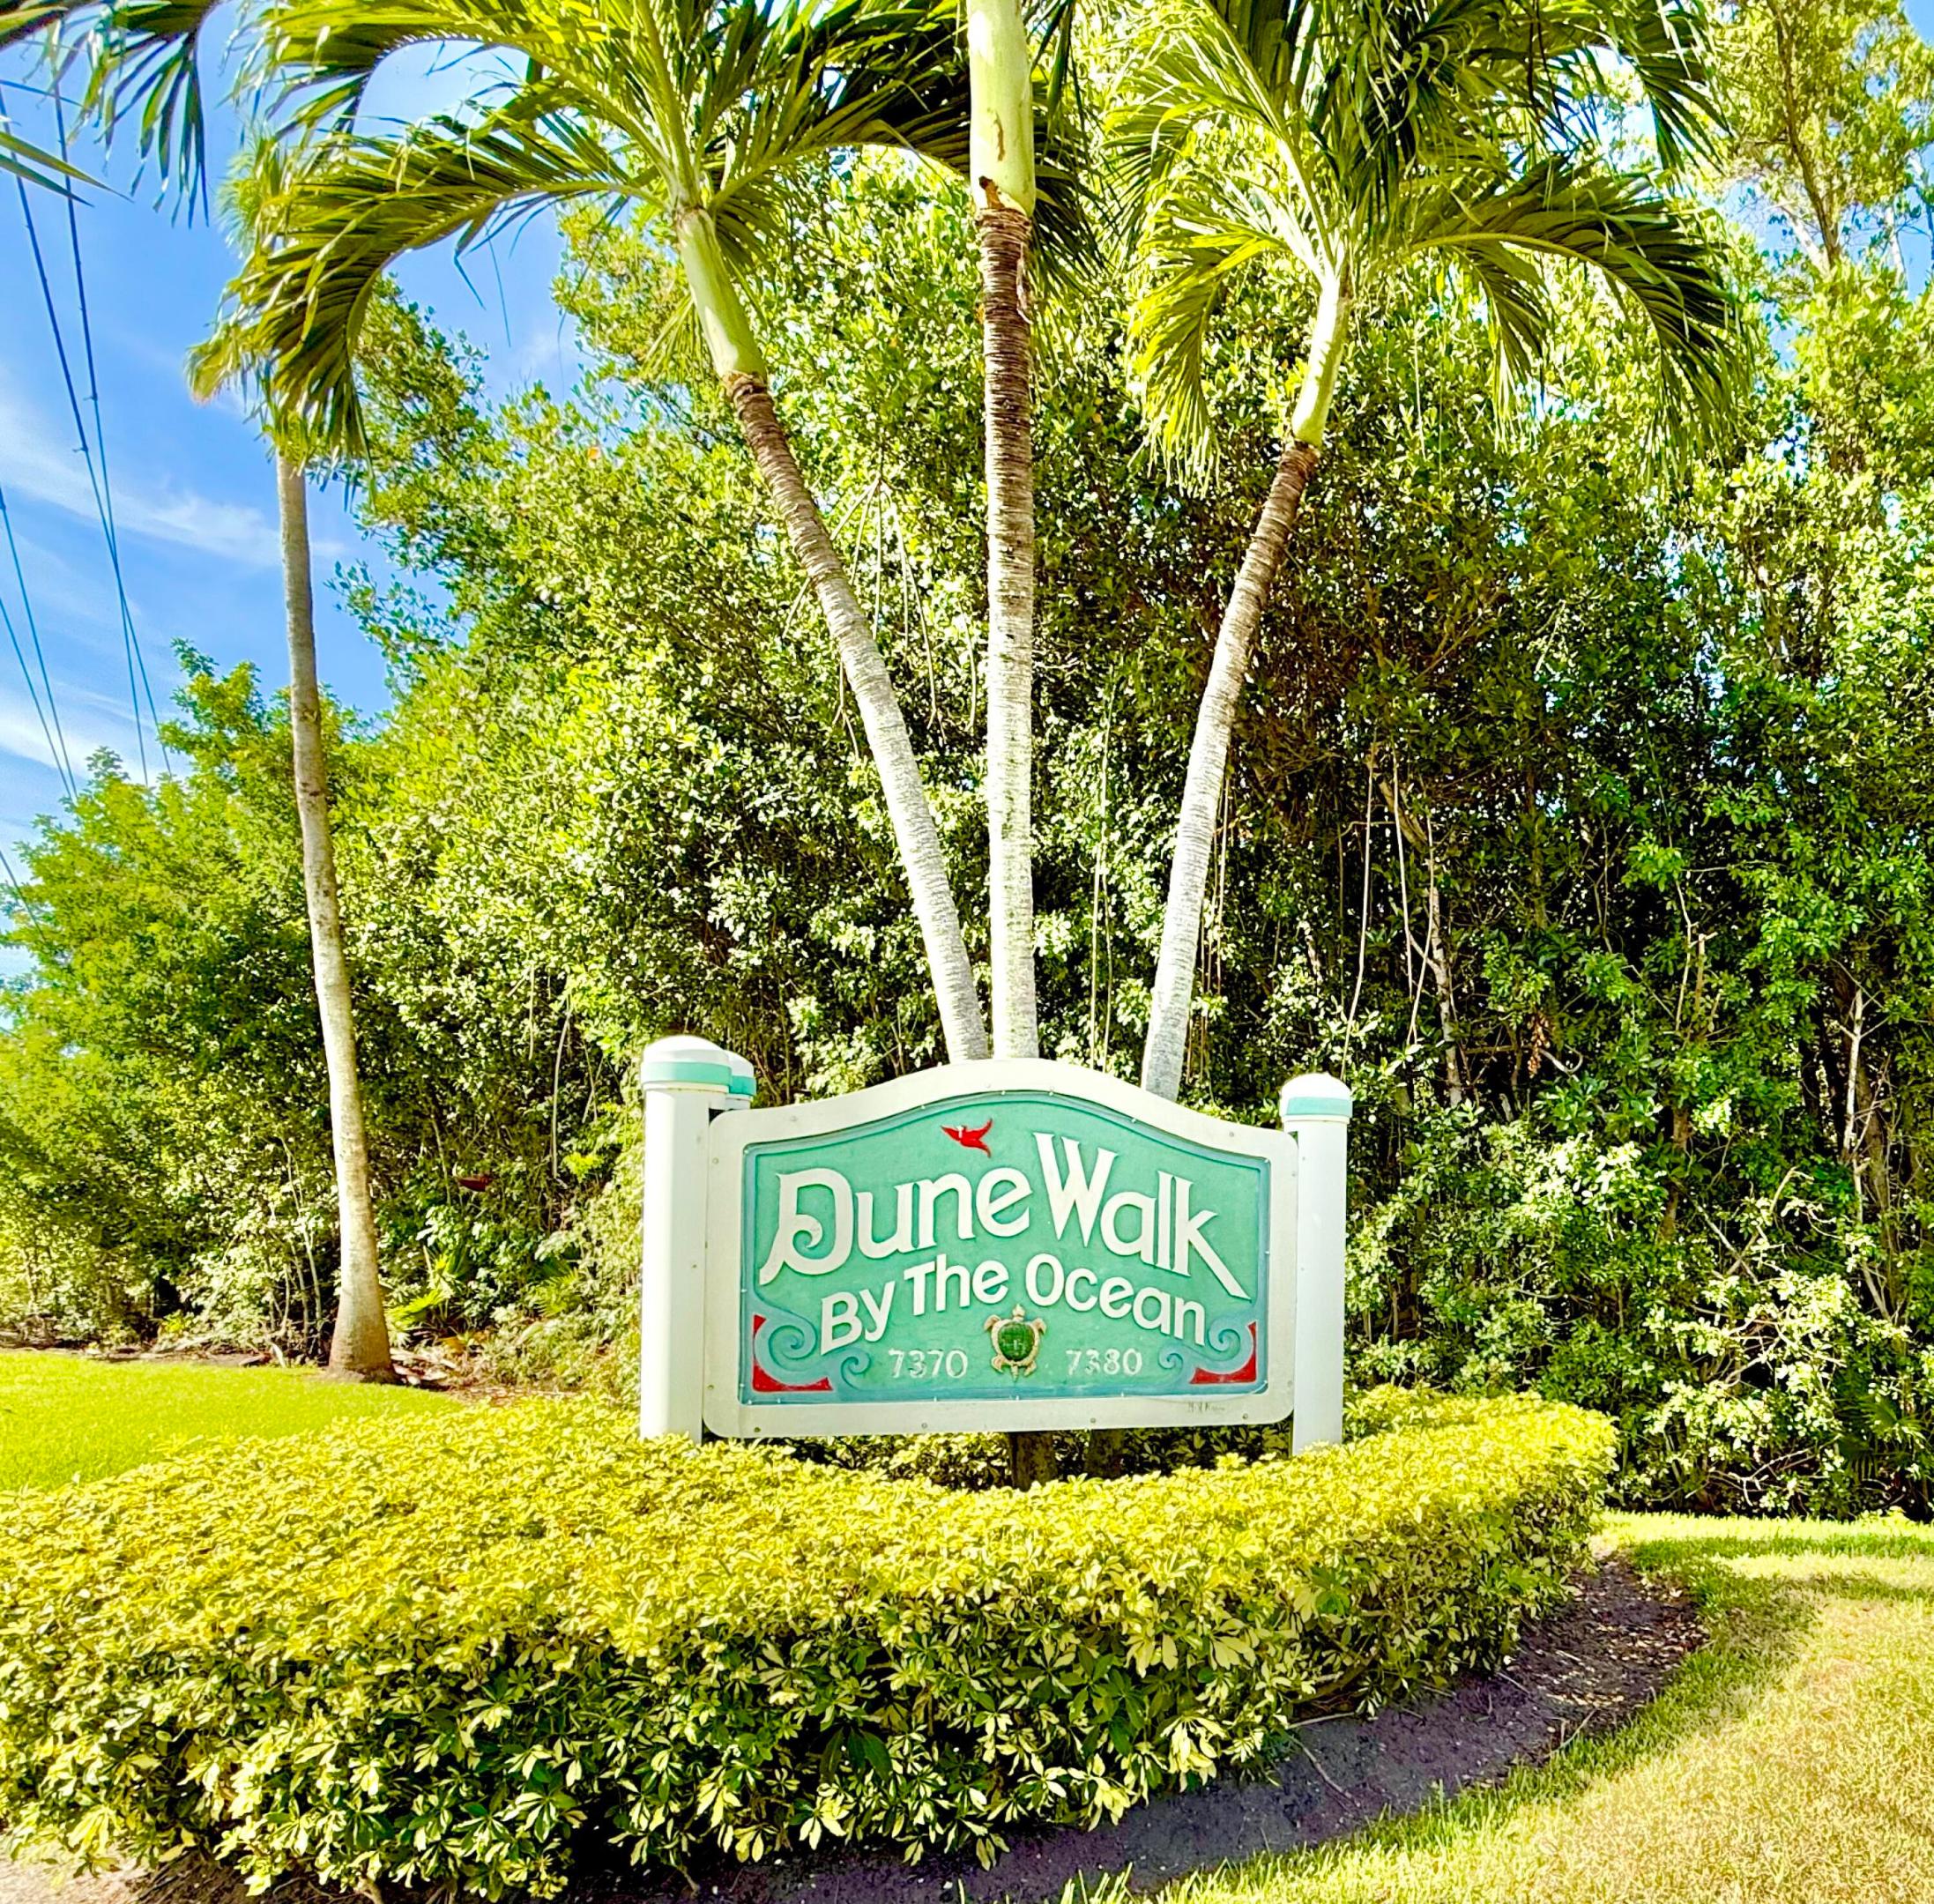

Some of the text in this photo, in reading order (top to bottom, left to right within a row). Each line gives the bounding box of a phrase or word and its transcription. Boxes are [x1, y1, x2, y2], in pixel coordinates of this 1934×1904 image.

[759, 1132, 1251, 1300] Dune Walk
[821, 1253, 1205, 1356] By The Ocean
[889, 1349, 968, 1380] 7370
[1066, 1348, 1142, 1377] 7380
